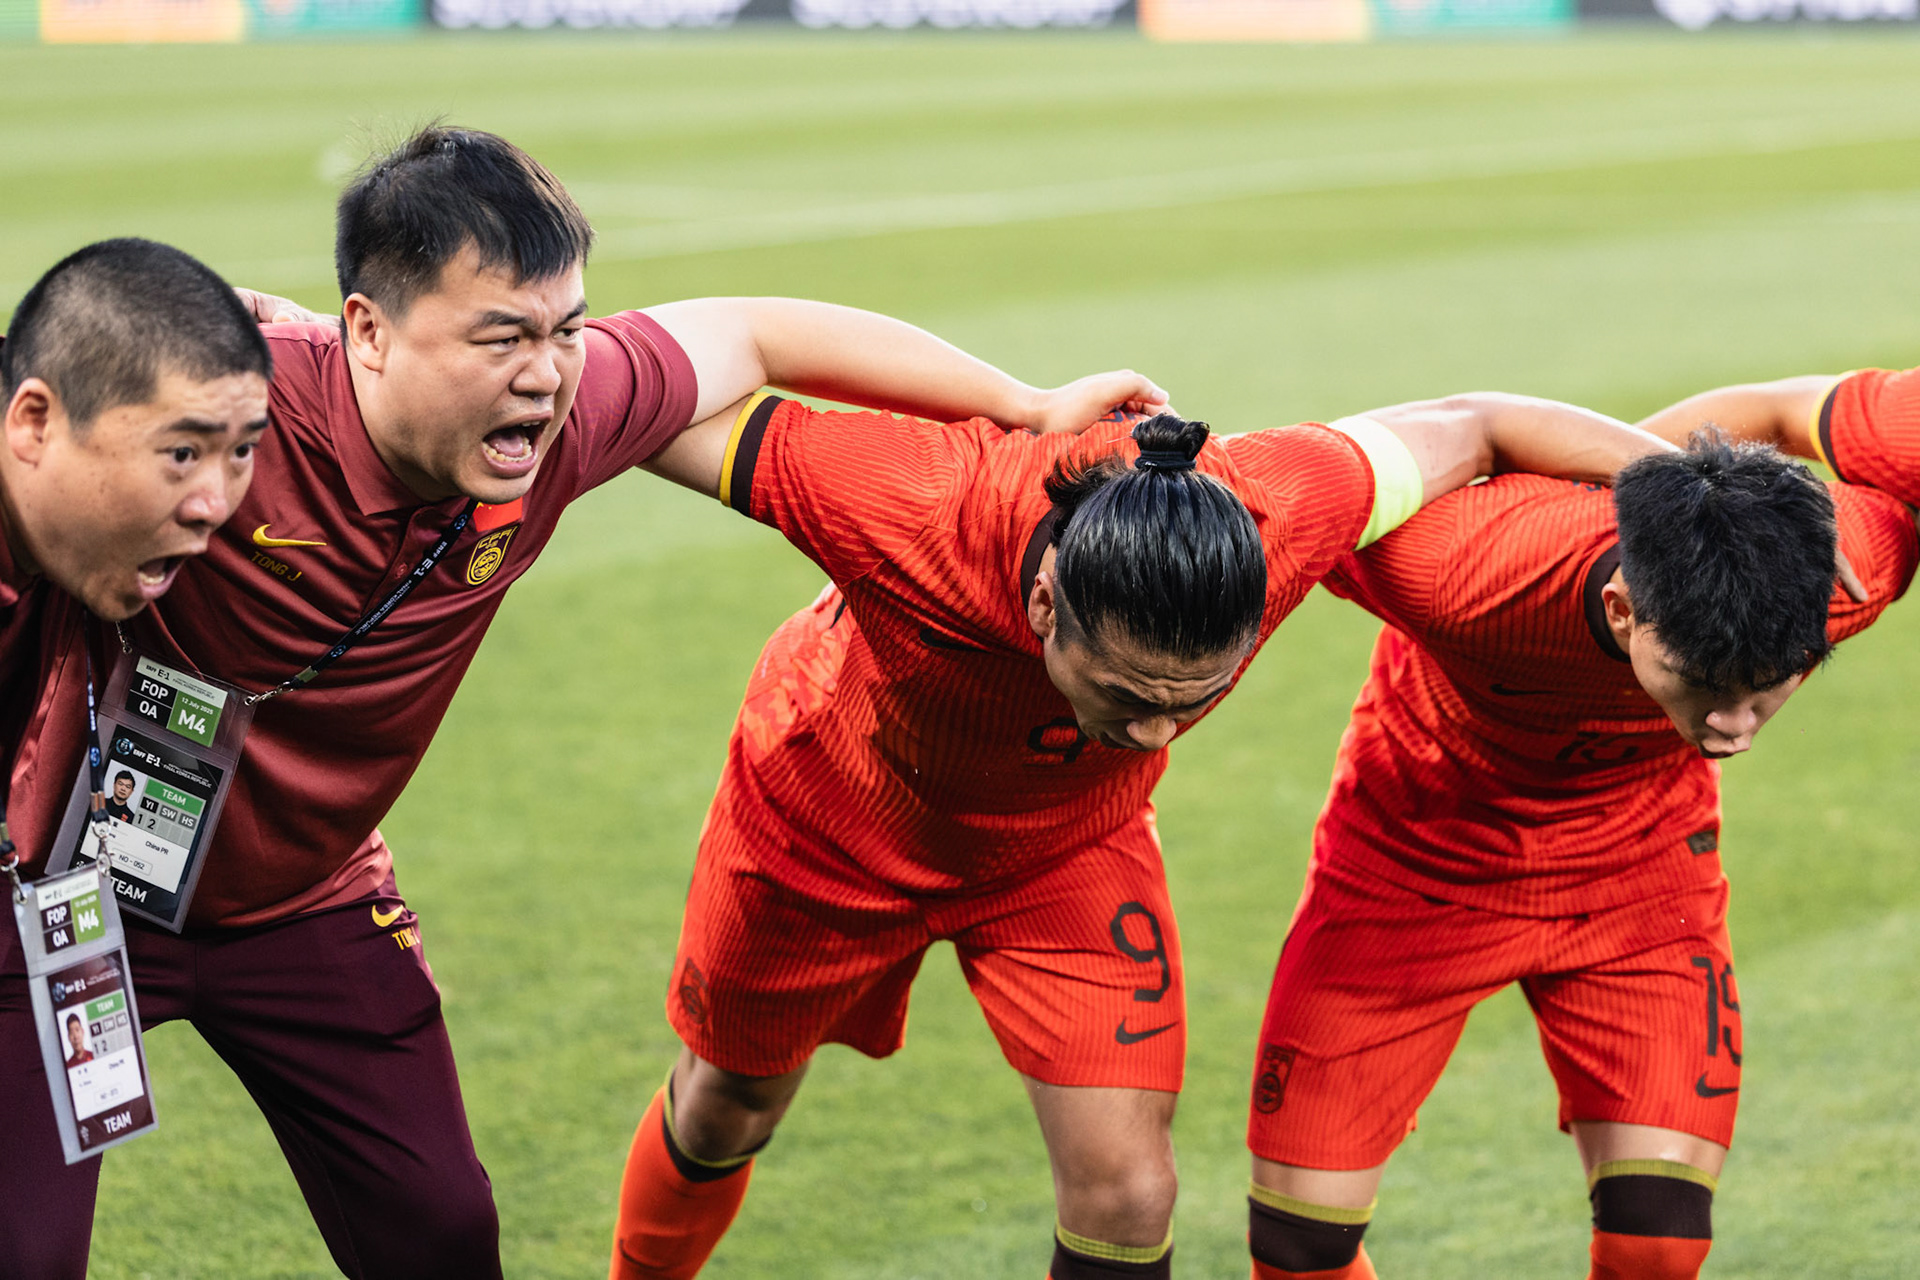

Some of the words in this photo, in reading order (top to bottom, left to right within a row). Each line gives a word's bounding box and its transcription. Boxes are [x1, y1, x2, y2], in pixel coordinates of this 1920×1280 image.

[251, 551, 287, 576] TONG
[287, 570, 303, 582] J
[413, 557, 434, 577] E-1
[157, 668, 170, 680] E-1
[140, 679, 169, 699] FOP
[139, 700, 157, 719] OA
[189, 701, 200, 710] July
[177, 709, 206, 735] M4
[145, 753, 162, 767] E-1
[162, 788, 187, 806] TEAM
[146, 800, 155, 810] YI
[161, 807, 177, 819] SW
[181, 816, 195, 827] HS
[147, 818, 156, 830] 2
[145, 840, 160, 852] China
[160, 847, 169, 855] PR
[119, 854, 129, 863] NO
[110, 876, 148, 903] TEAM
[46, 905, 67, 927] FOP
[77, 908, 100, 933] M4
[52, 928, 70, 948] OA
[1110, 901, 1171, 1003] 9
[96, 998, 115, 1014] TEAM
[103, 1110, 133, 1134] TEAM
